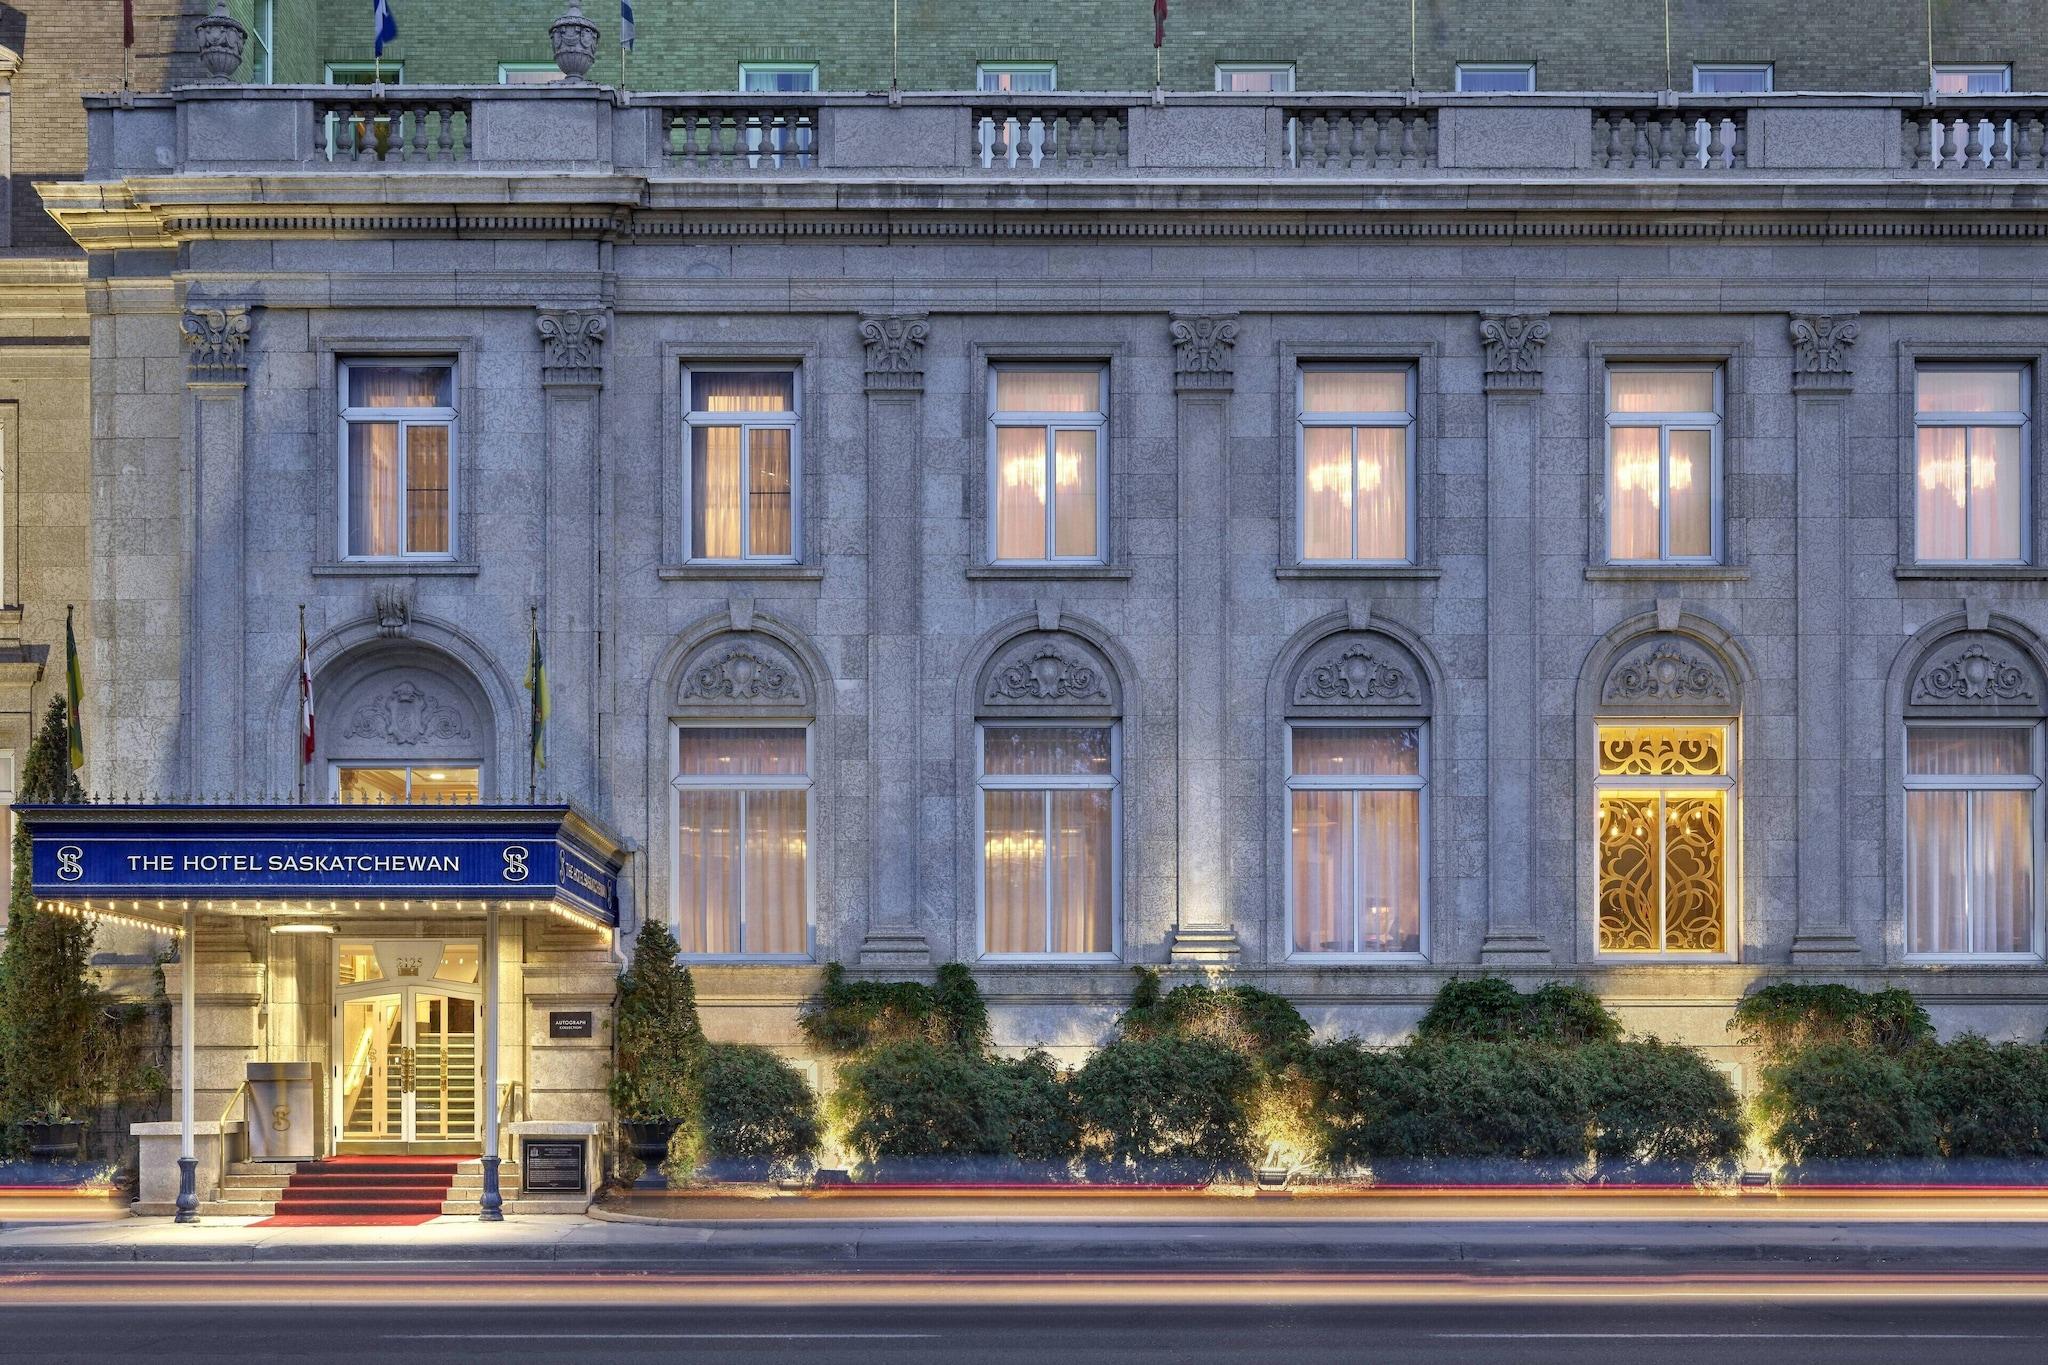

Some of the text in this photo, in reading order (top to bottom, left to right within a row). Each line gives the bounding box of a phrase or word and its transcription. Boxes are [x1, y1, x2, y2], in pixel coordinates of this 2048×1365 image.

[127, 855, 460, 872] THE HOTEL SASKATCHEWAN
